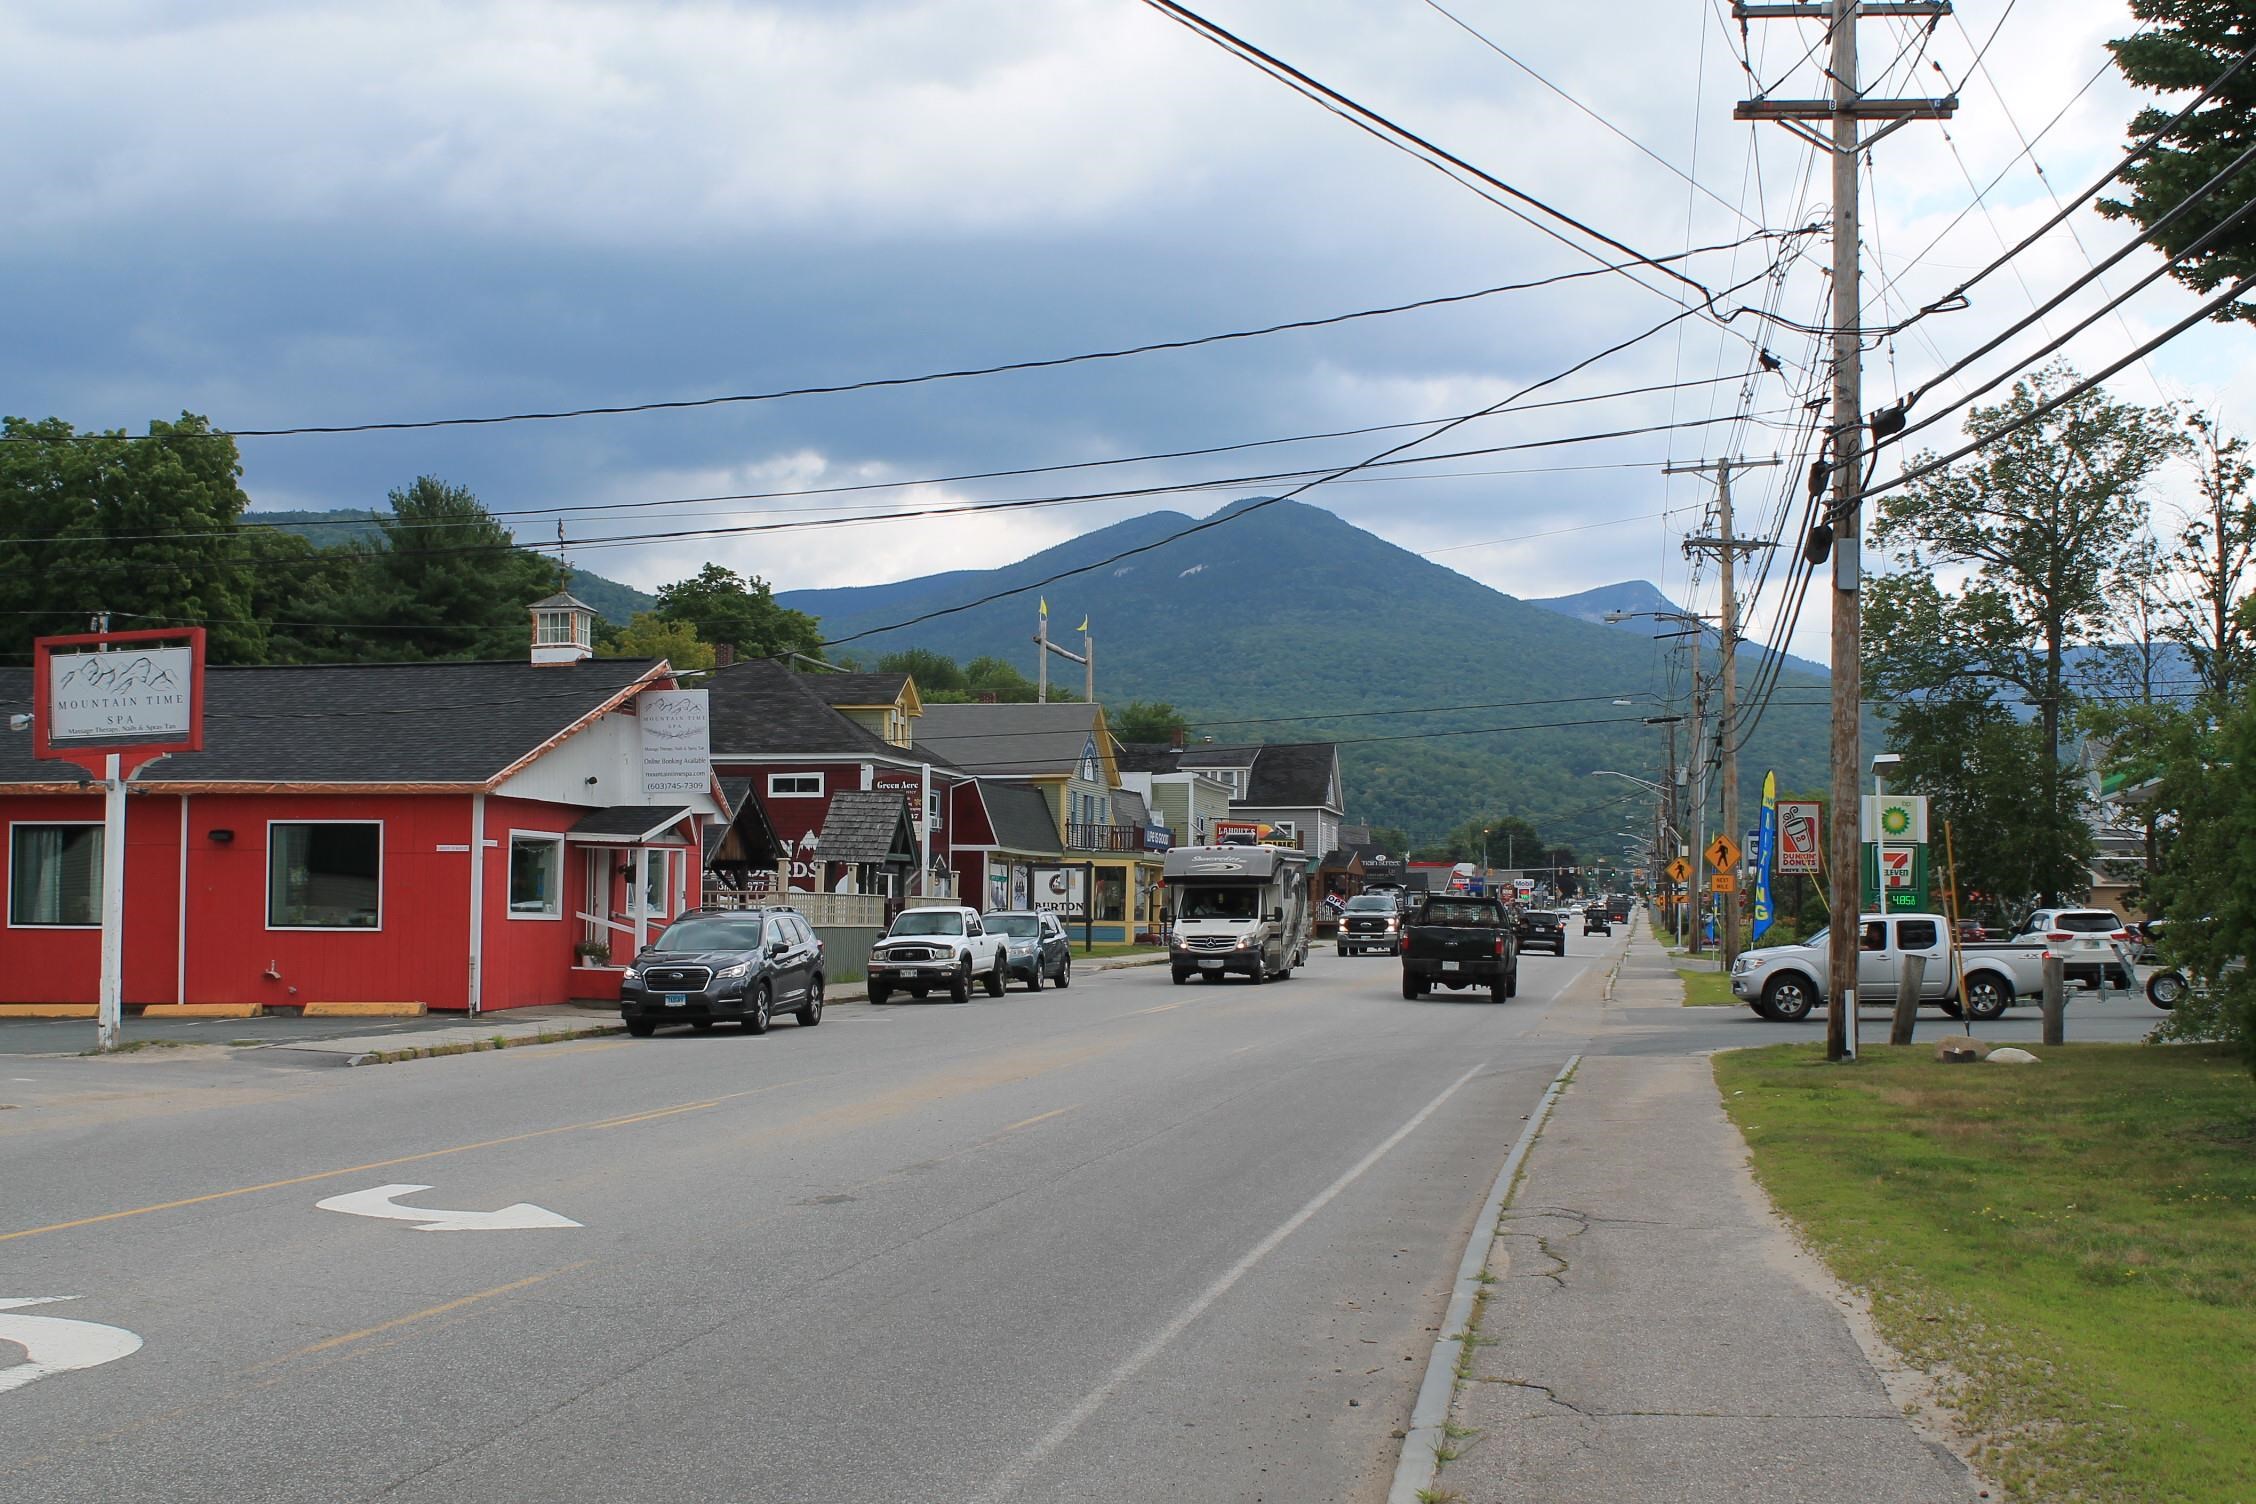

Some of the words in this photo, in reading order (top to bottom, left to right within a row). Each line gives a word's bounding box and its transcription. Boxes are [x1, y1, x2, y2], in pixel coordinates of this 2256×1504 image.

[58, 697, 137, 710] MOUNTAIN
[146, 694, 184, 705] TIME
[107, 715, 134, 725] SPA
[68, 727, 94, 735] Massage
[647, 782, 703, 791] (603)745-7309
[877, 780, 899, 789] Green
[1328, 896, 1346, 908] OPE
